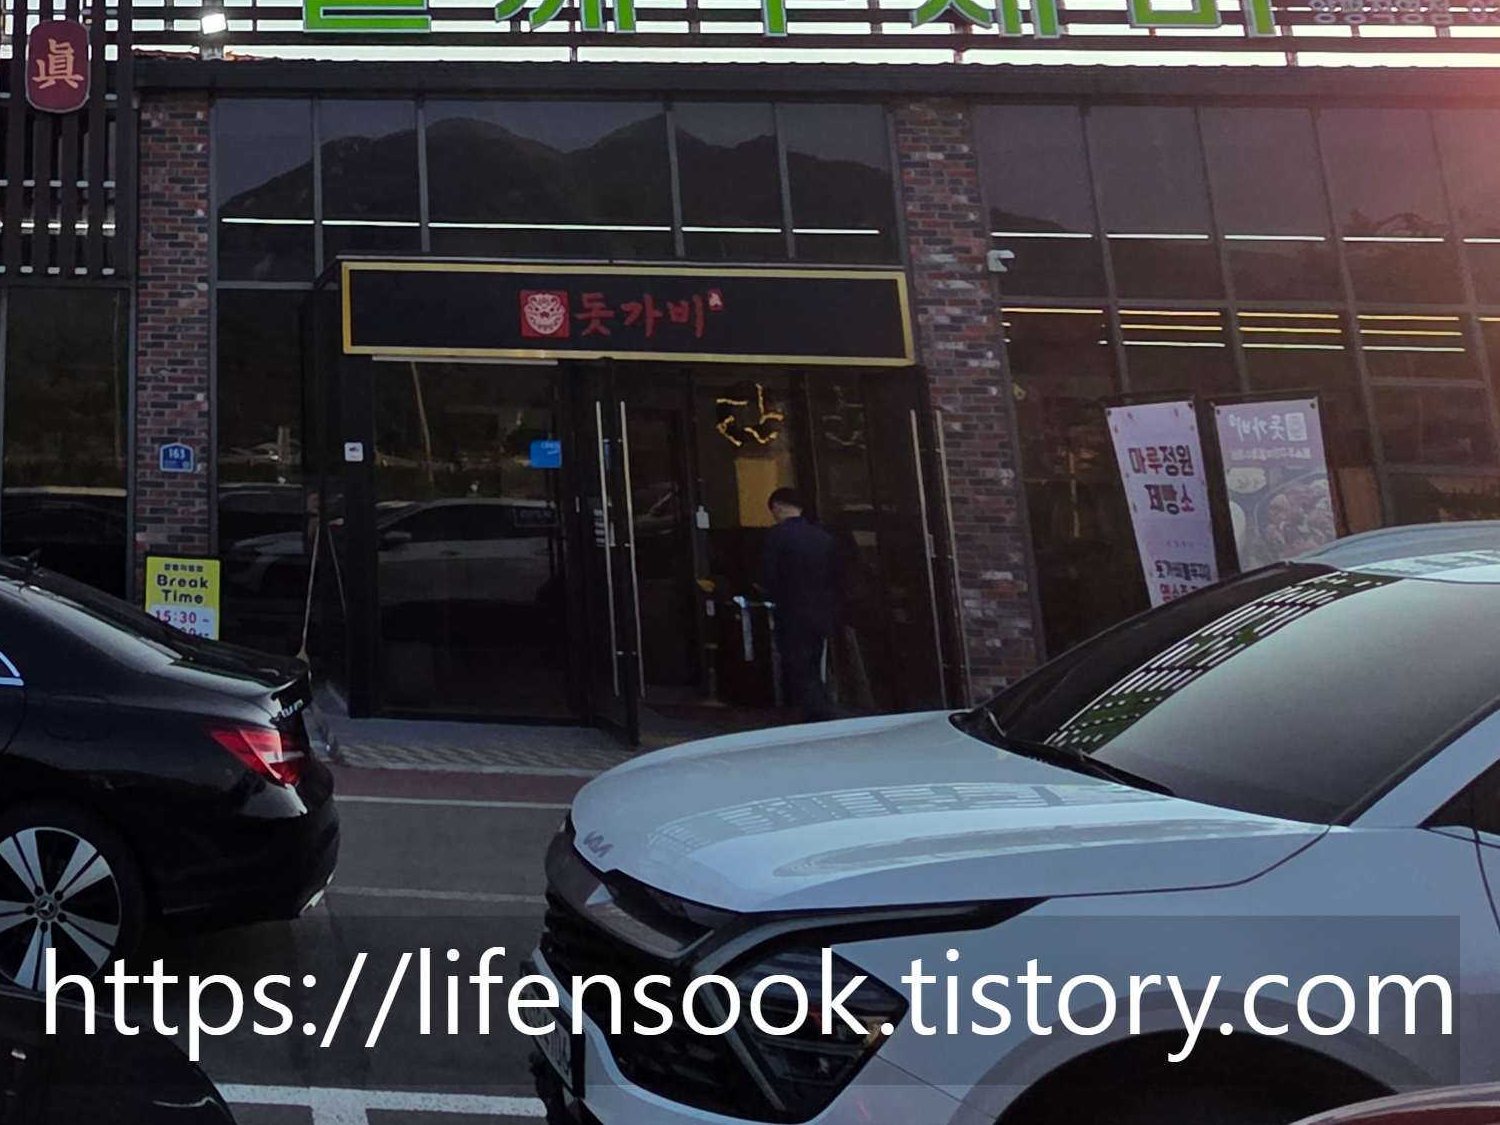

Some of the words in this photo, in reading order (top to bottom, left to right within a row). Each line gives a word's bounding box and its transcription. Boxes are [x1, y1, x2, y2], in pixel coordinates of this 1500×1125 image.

[575, 291, 705, 338] 돗가비
[168, 448, 186, 460] 163
[1127, 444, 1195, 477] 마루정원
[1144, 483, 1196, 515] 제빵소
[157, 574, 209, 589] Break
[161, 589, 204, 604] Time
